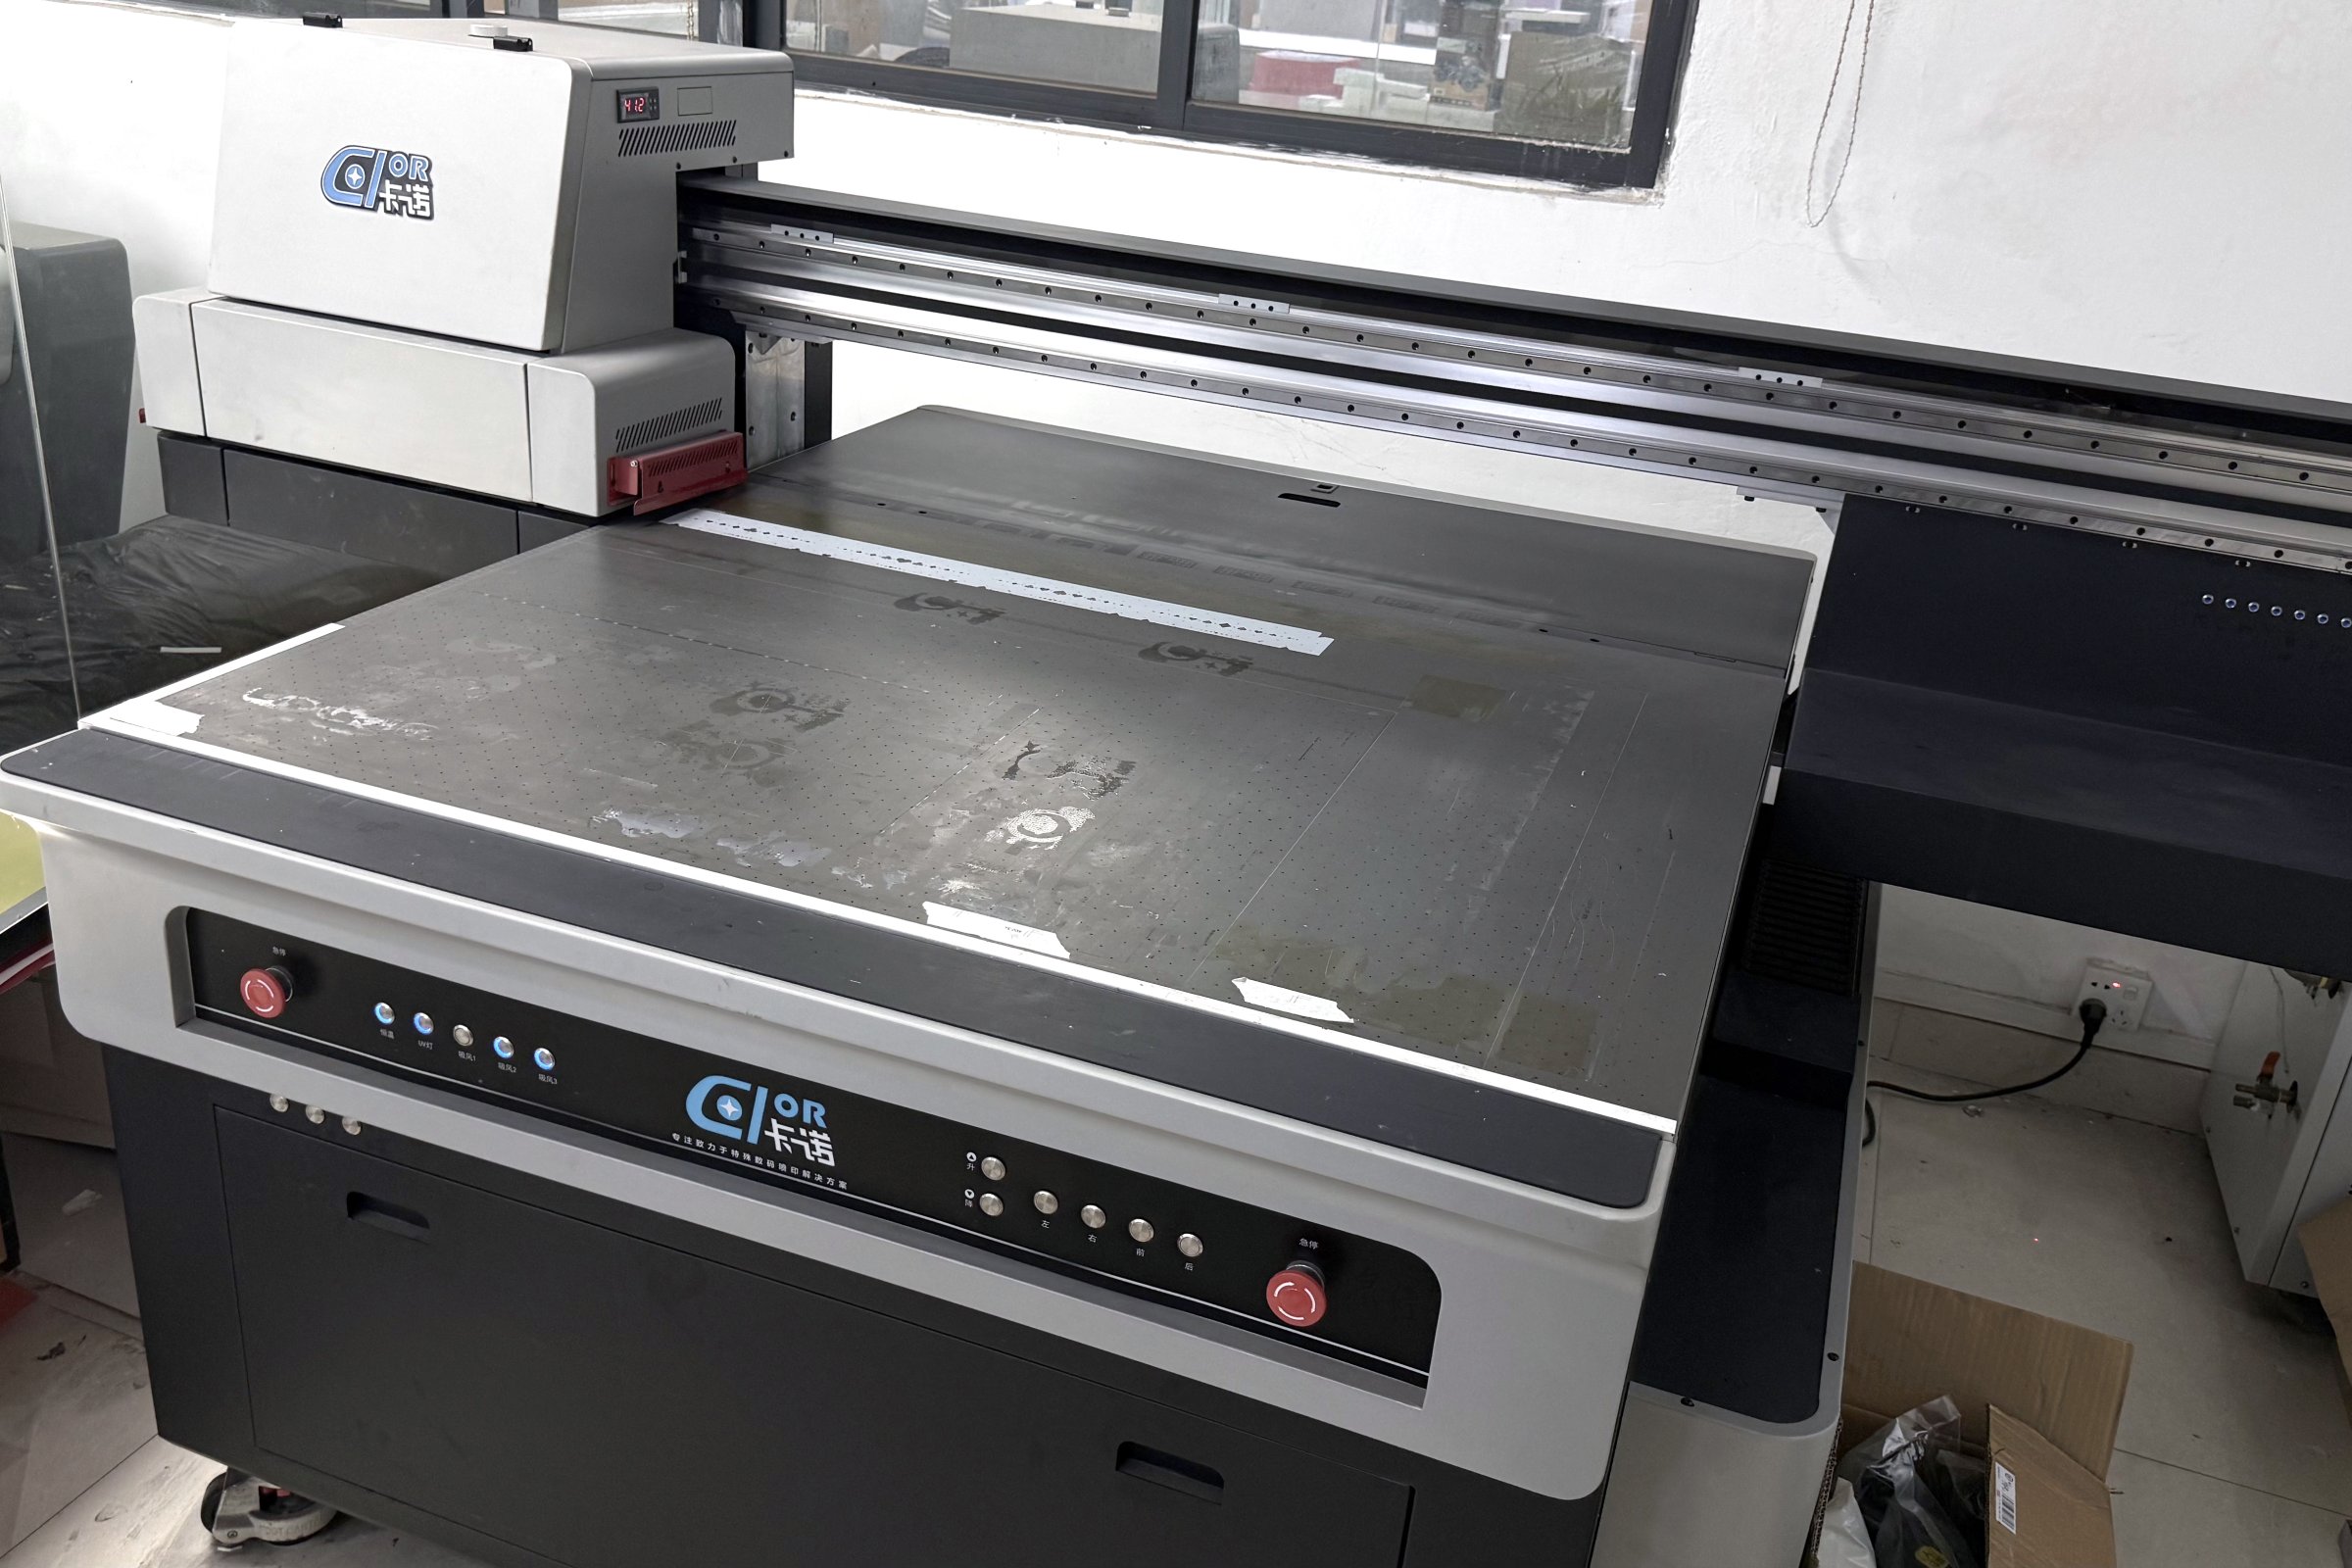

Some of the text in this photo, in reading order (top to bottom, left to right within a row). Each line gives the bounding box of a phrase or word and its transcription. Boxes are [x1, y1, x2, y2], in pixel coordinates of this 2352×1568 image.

[378, 178, 431, 218] 卡诺
[417, 1040, 433, 1051] UV灯
[458, 1051, 476, 1062] 吸风1
[498, 1062, 517, 1073] 吸风2
[763, 1117, 836, 1167] 卡诺
[671, 1132, 848, 1191] 专注致力于特殊数码喷印解决方案
[966, 1162, 976, 1172] 升
[1041, 1219, 1051, 1229] 左
[1087, 1234, 1097, 1244] 右
[1298, 1237, 1319, 1250] 急停
[1136, 1248, 1146, 1257] 前
[1184, 1262, 1194, 1272] 后
